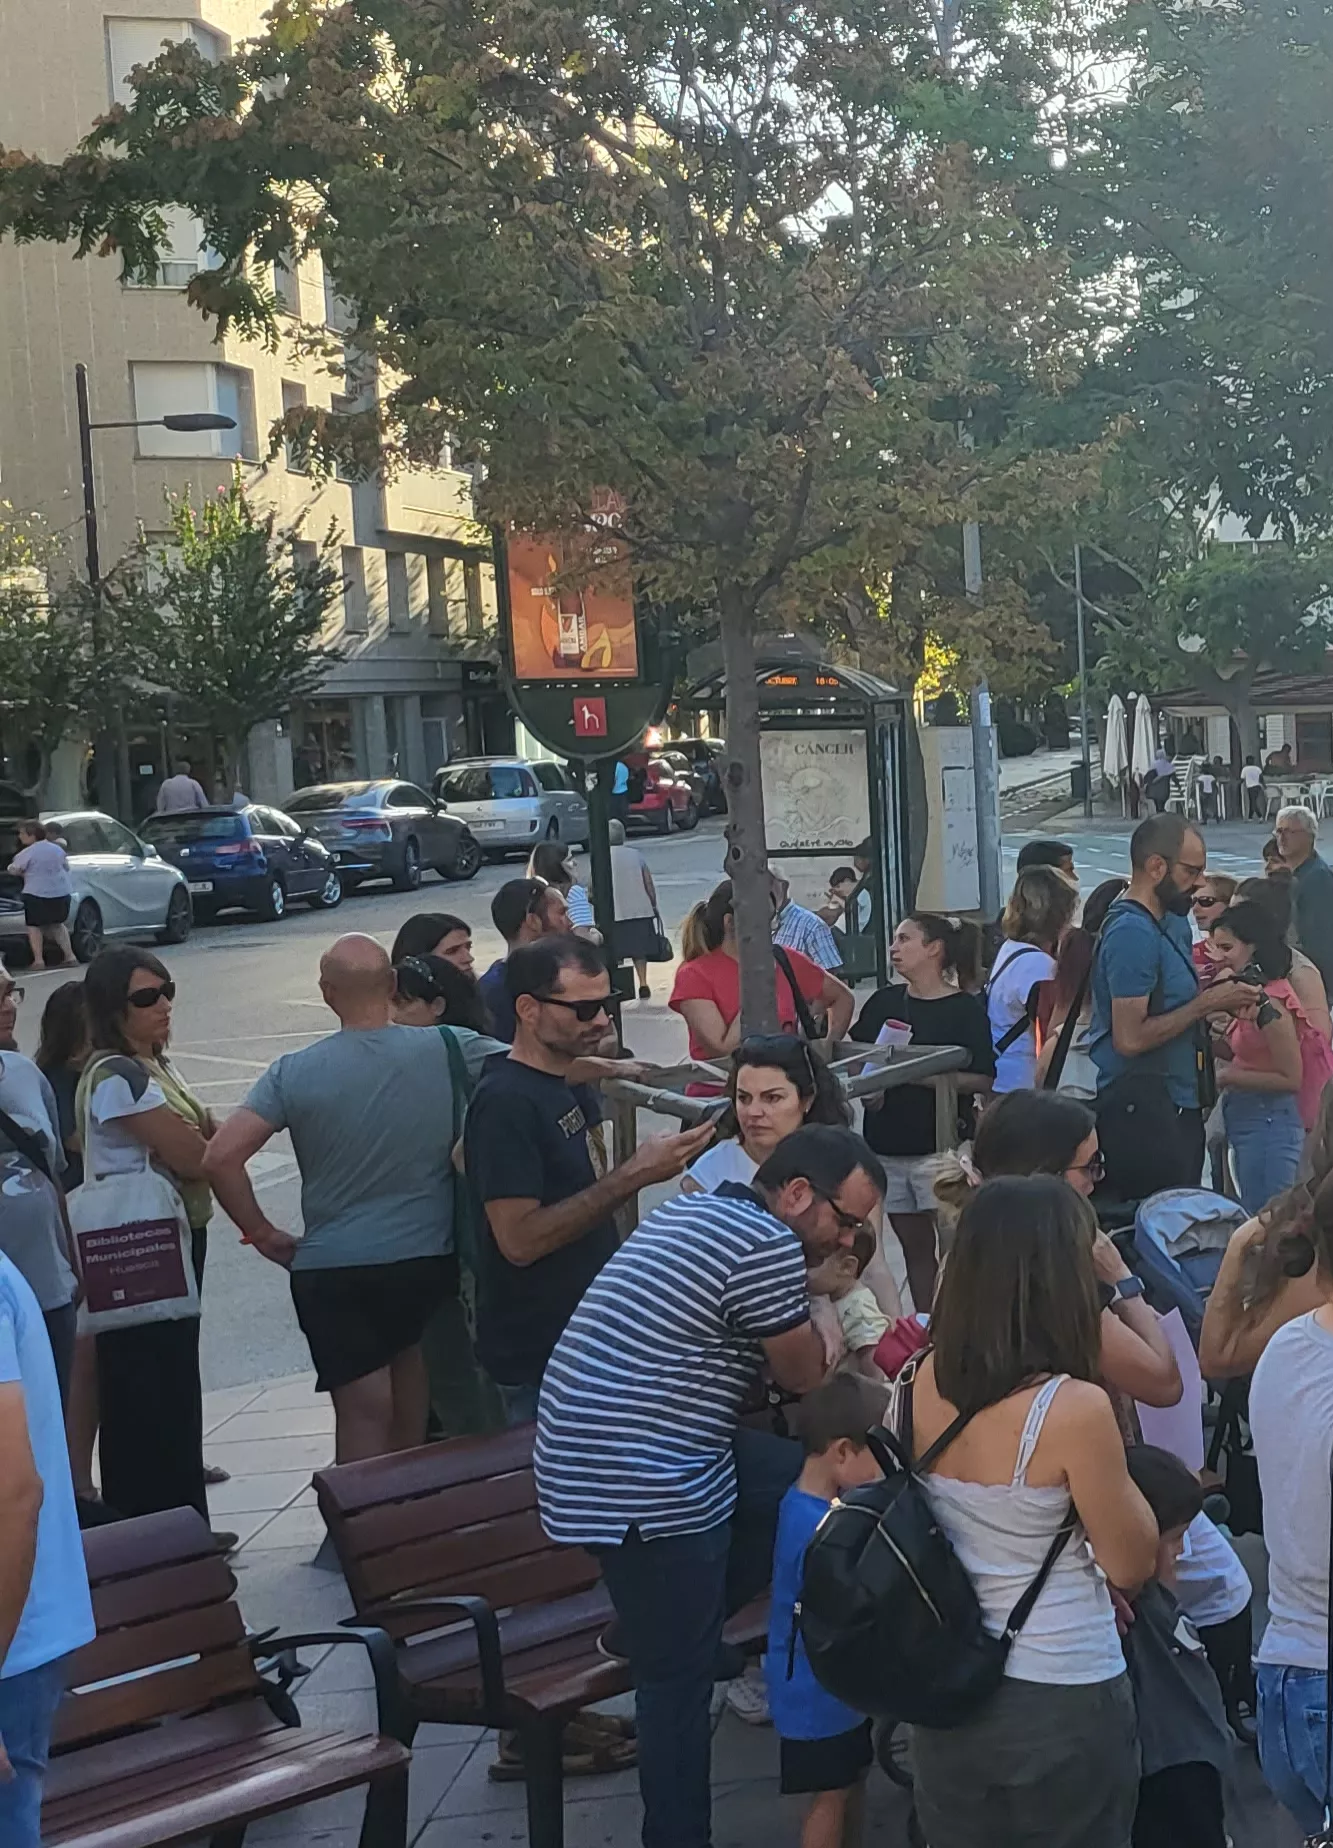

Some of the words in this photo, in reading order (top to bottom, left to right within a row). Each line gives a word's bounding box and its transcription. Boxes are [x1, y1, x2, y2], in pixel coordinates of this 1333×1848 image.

[794, 741, 854, 755] CÁNCER
[86, 1227, 172, 1248] Bibliotecas
[86, 1243, 176, 1264] Municipales
